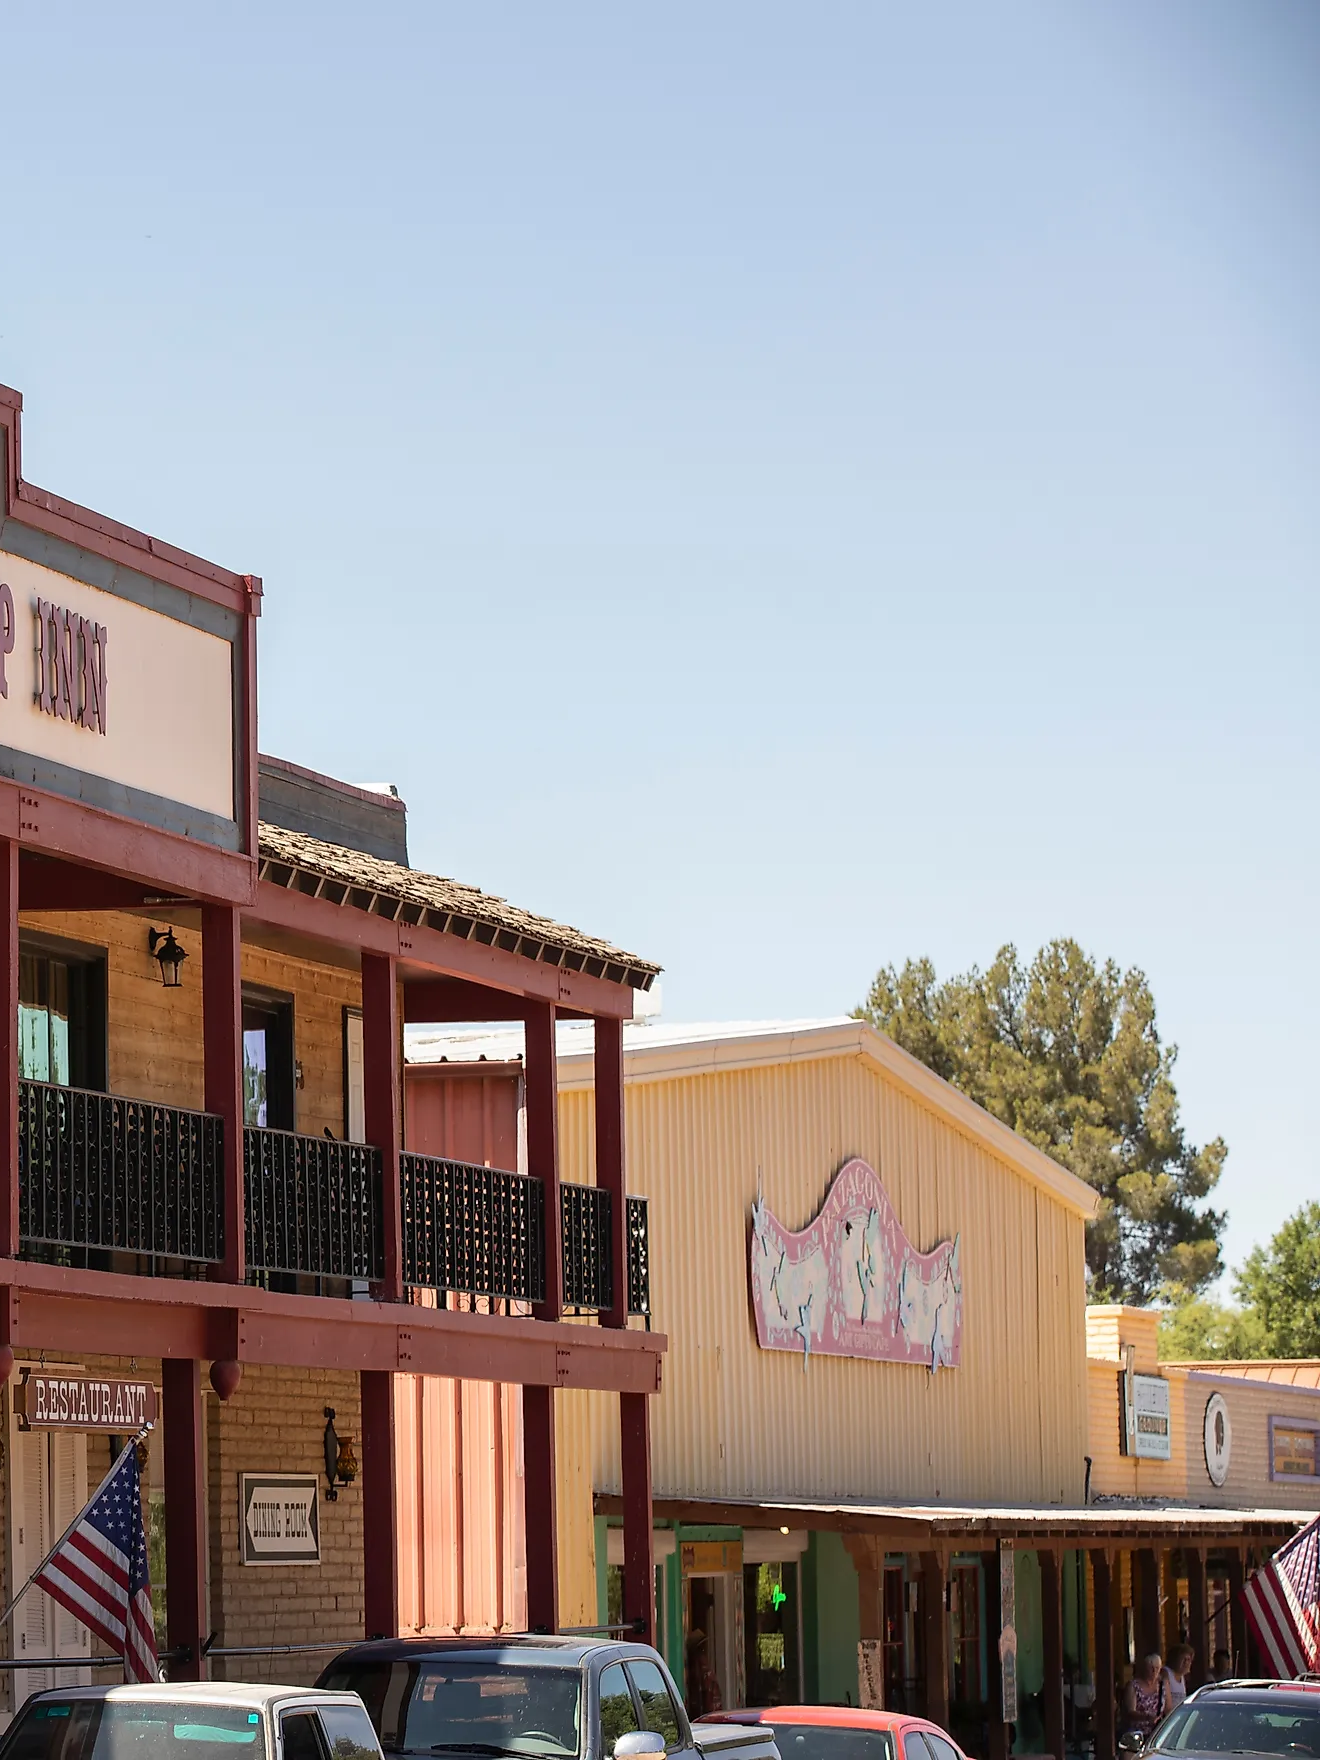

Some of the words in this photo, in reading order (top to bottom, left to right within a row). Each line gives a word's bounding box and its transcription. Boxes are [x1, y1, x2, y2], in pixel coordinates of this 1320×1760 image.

[36, 596, 109, 737] INN
[822, 1167, 898, 1254] PATAGONIA
[35, 1379, 147, 1424] RESTAURANT
[253, 1502, 281, 1538] DINING
[284, 1502, 308, 1538] ROOM
[862, 1642, 876, 1650] NO
